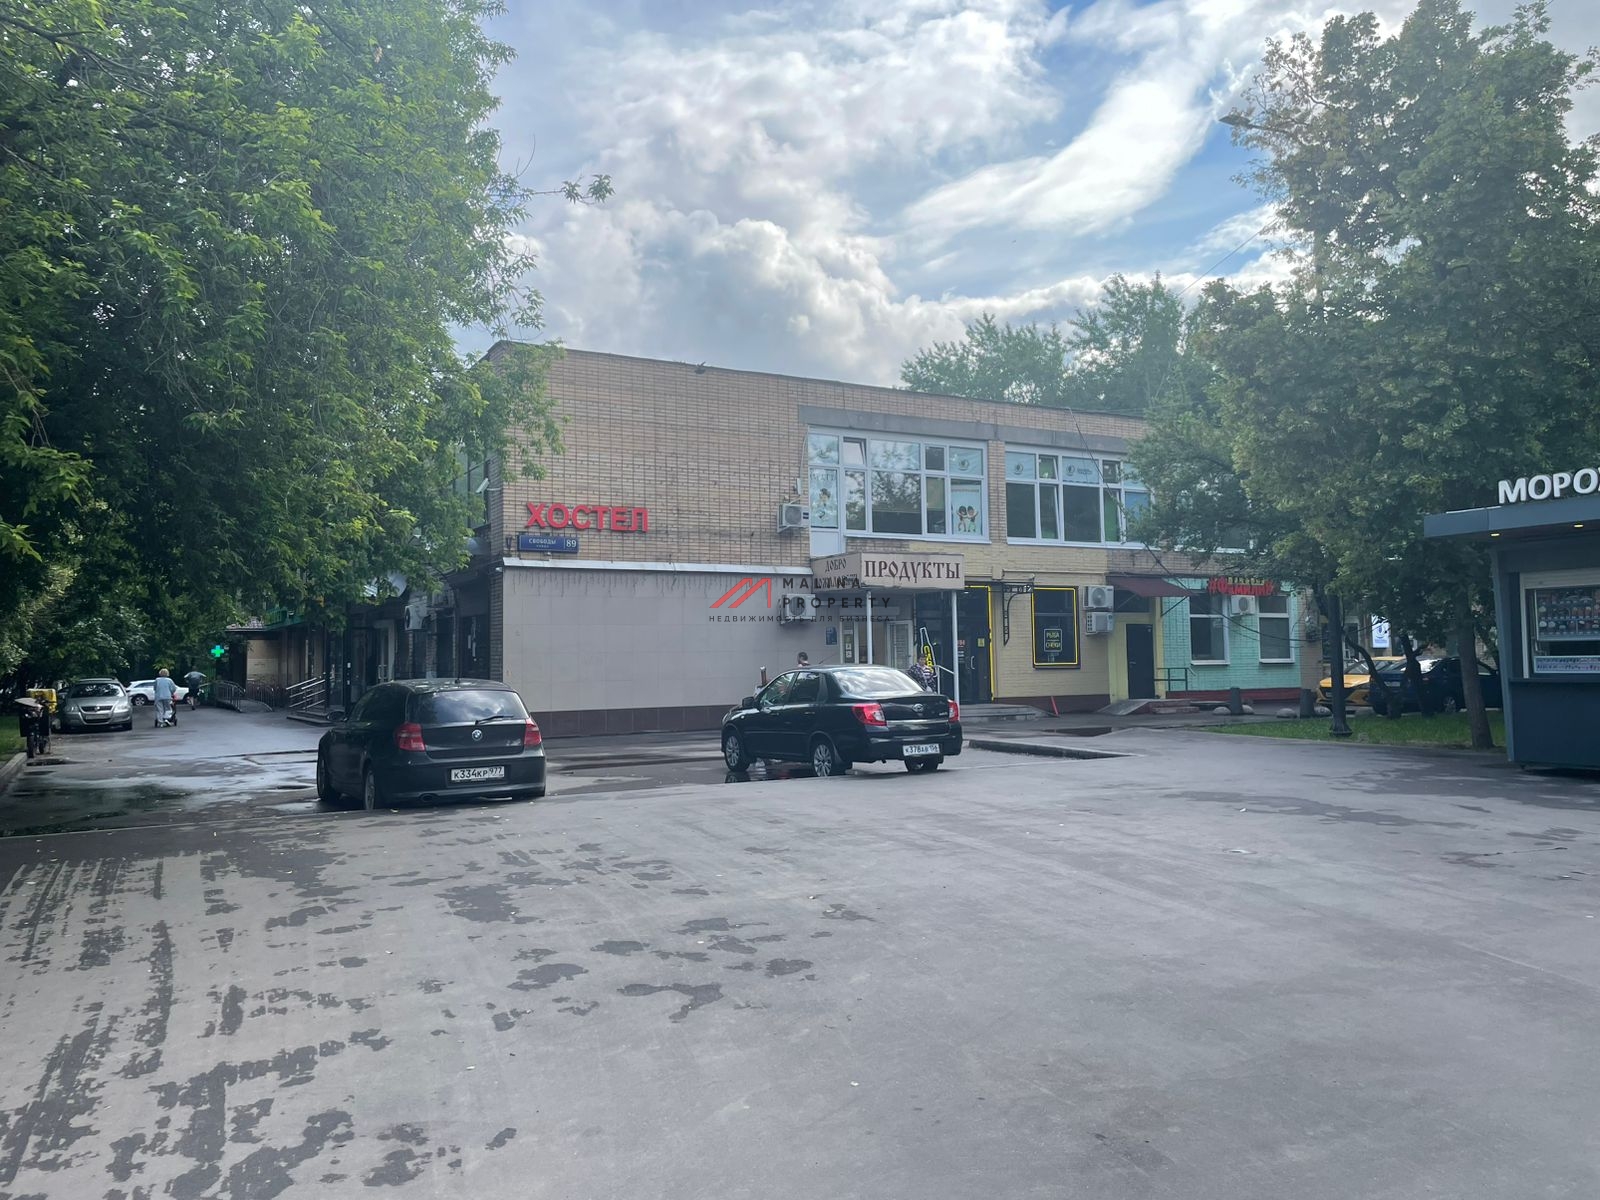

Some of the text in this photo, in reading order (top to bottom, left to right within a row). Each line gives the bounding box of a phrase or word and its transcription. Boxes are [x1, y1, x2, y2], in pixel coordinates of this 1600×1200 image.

[1497, 467, 1600, 504] МОРО
[525, 502, 649, 532] ХОСТЕЛ
[566, 539, 577, 548] 89
[864, 560, 961, 583] ПРОДУКТЫ
